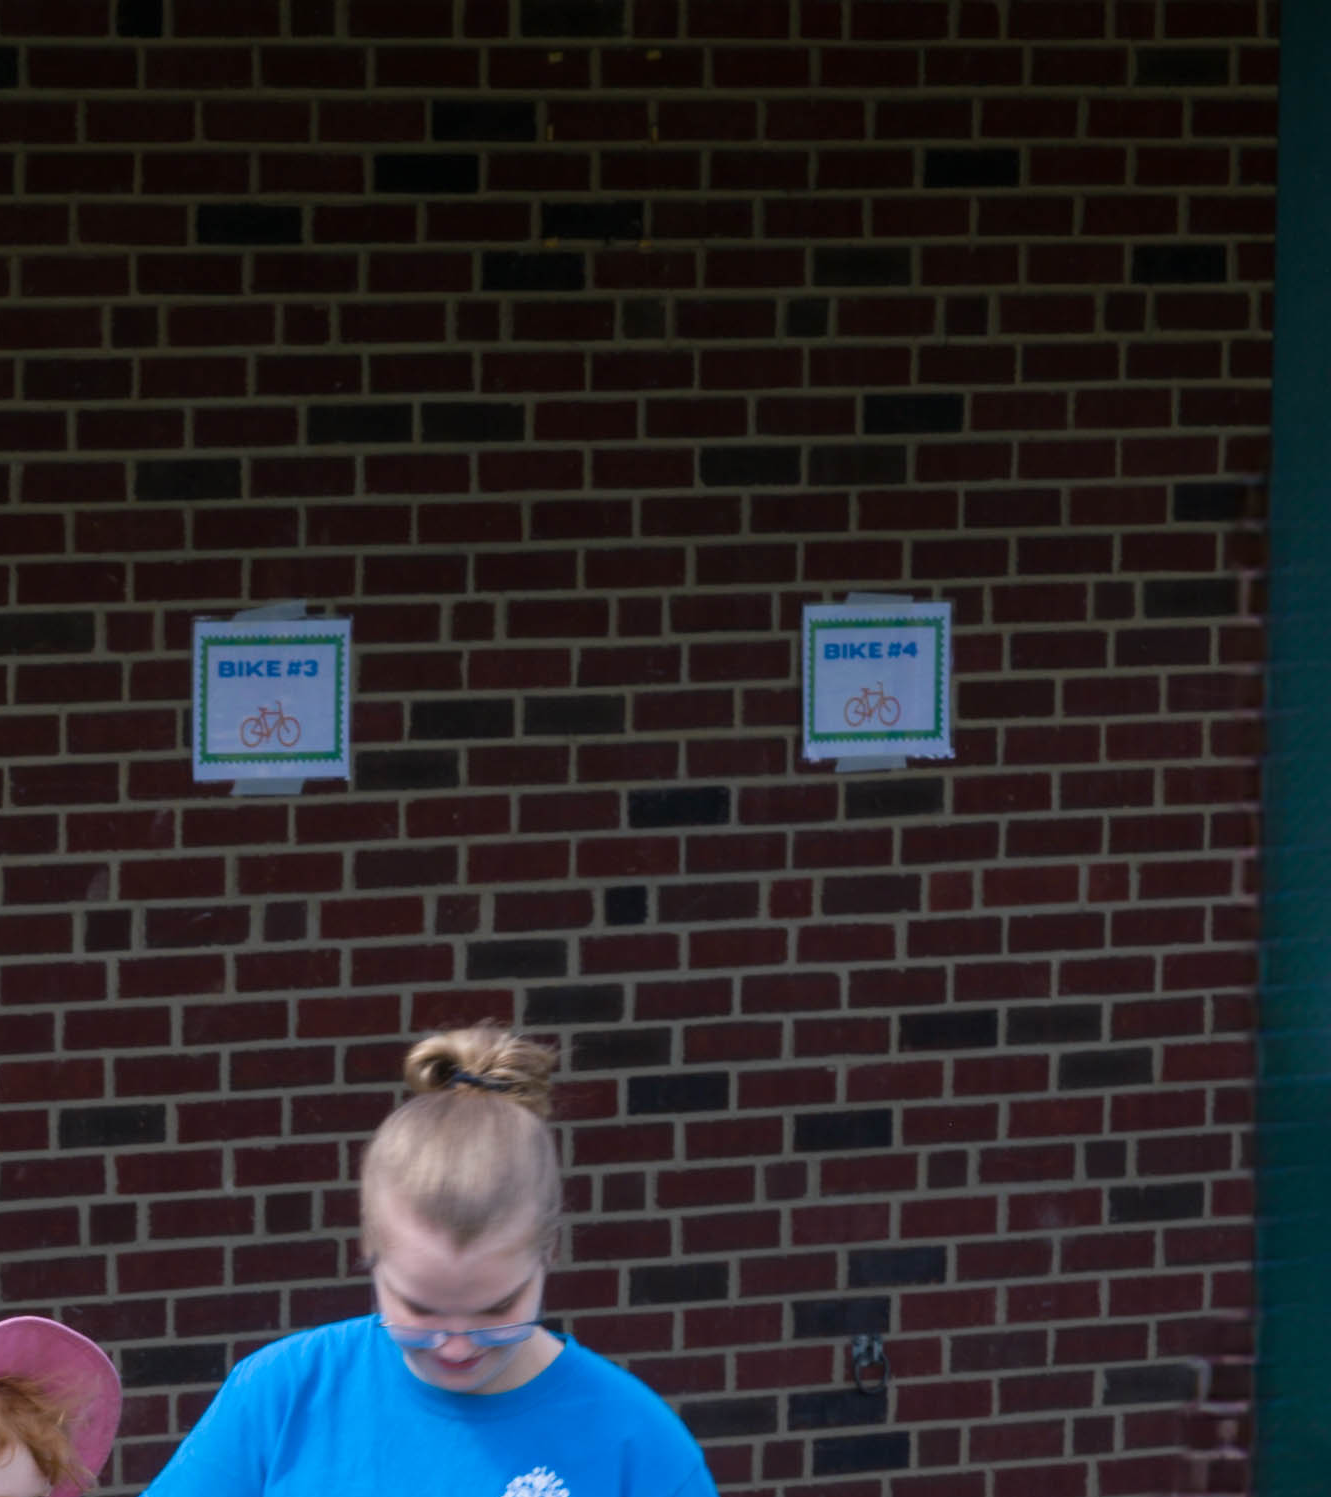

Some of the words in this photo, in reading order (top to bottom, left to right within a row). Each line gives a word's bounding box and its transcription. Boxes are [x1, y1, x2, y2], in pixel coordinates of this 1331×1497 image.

[824, 642, 883, 660] BIKE
[887, 641, 918, 658] #4
[218, 660, 282, 678] BIKE
[286, 659, 319, 677] #3
